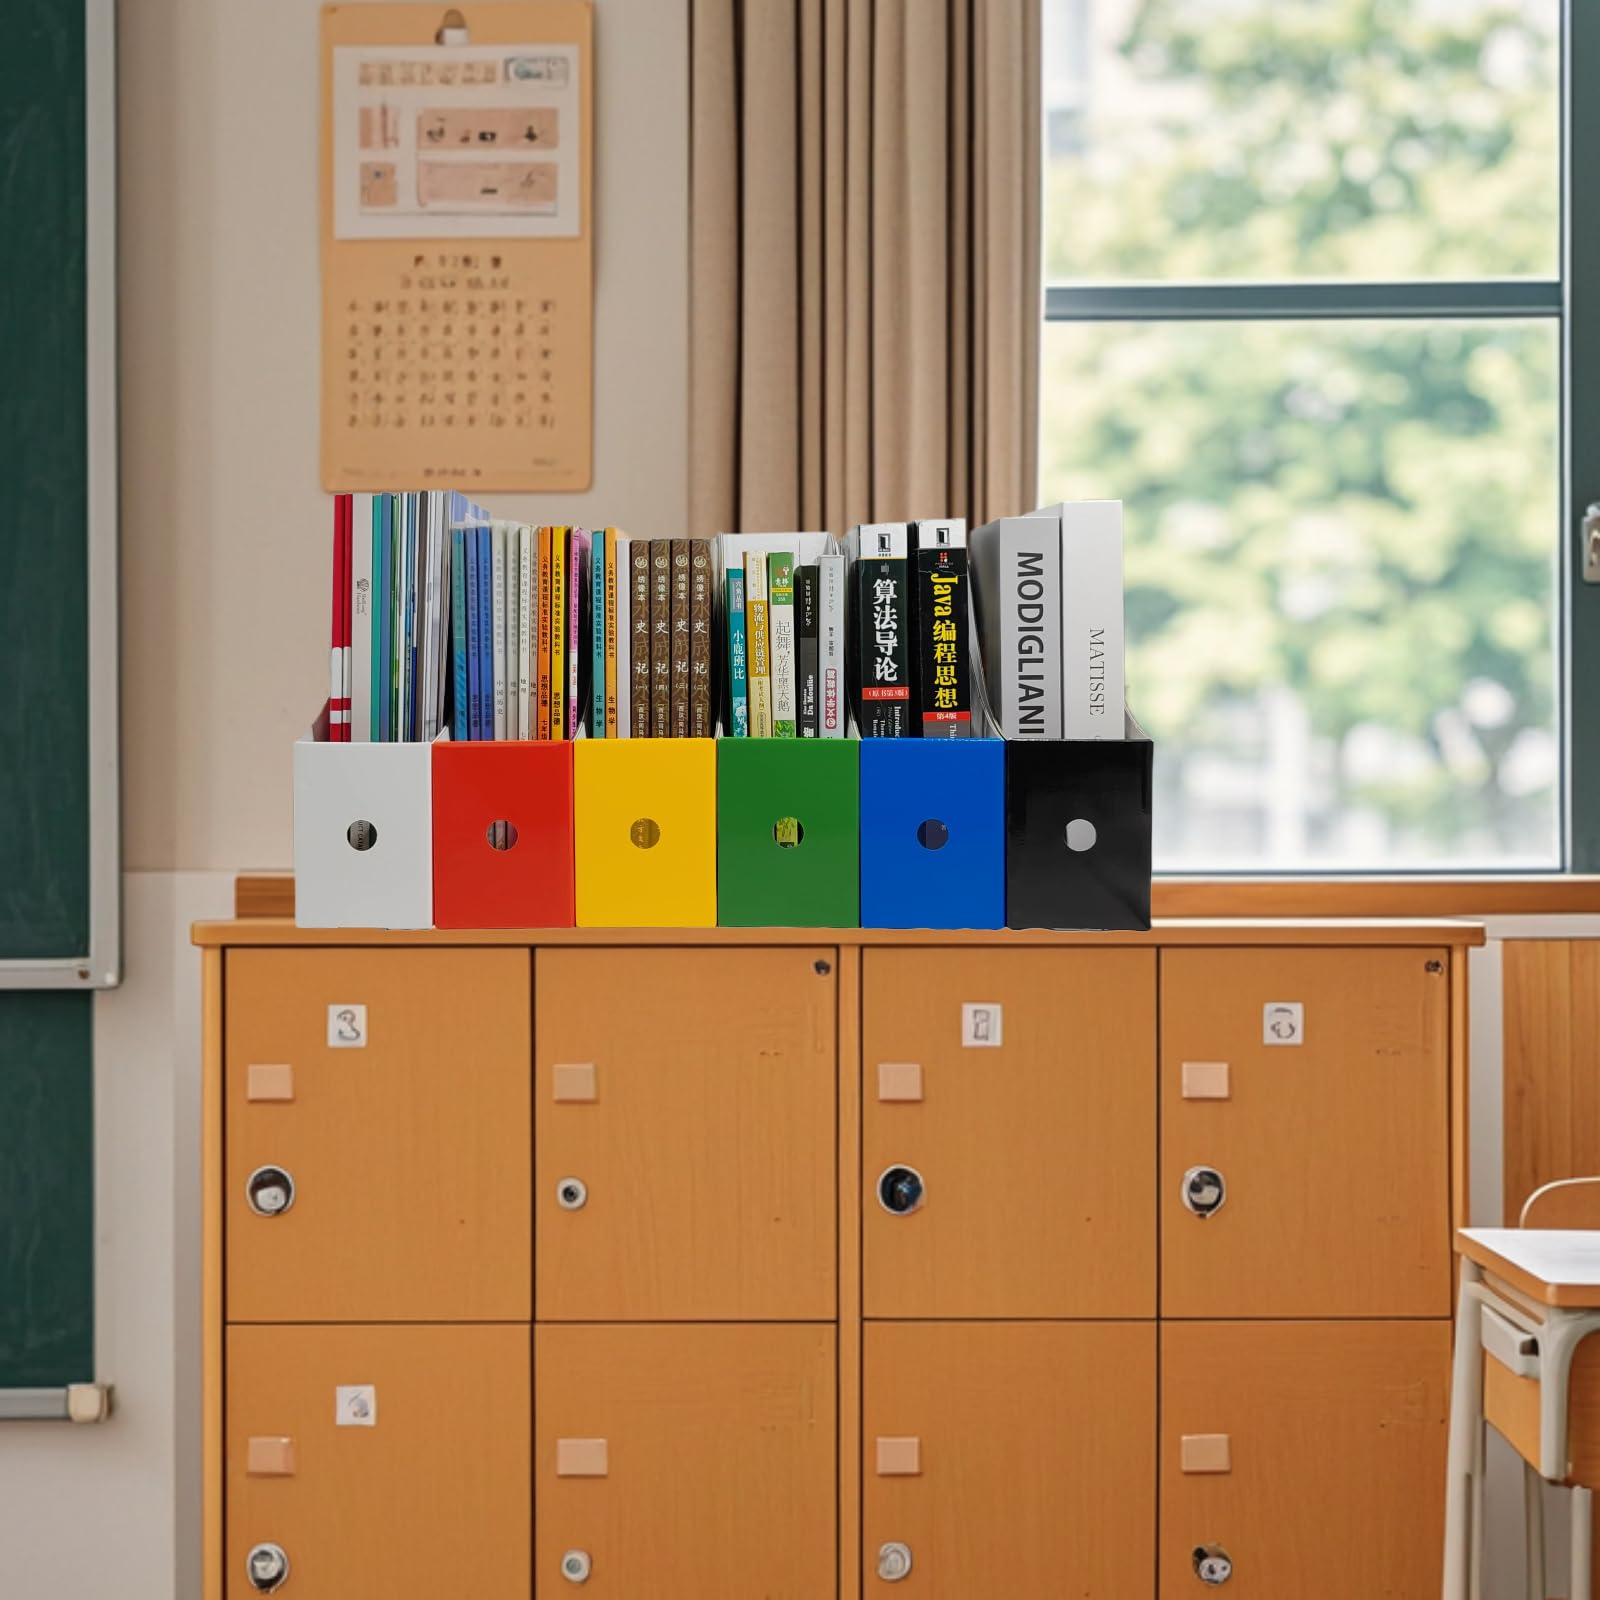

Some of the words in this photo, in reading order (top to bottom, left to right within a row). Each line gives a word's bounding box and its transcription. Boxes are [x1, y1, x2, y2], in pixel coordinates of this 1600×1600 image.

[930, 572, 959, 617] Java
[733, 629, 745, 680] 小鹿班比
[753, 603, 766, 674] 物流与供应链管理
[872, 578, 898, 682] 算法导论
[1016, 552, 1045, 734] MODIGLIANI
[932, 619, 958, 709] 编程思想
[1089, 628, 1105, 716] MATISSE
[553, 692, 561, 726] 思想品德
[595, 694, 603, 728] 生物学
[607, 696, 616, 726] 生物学
